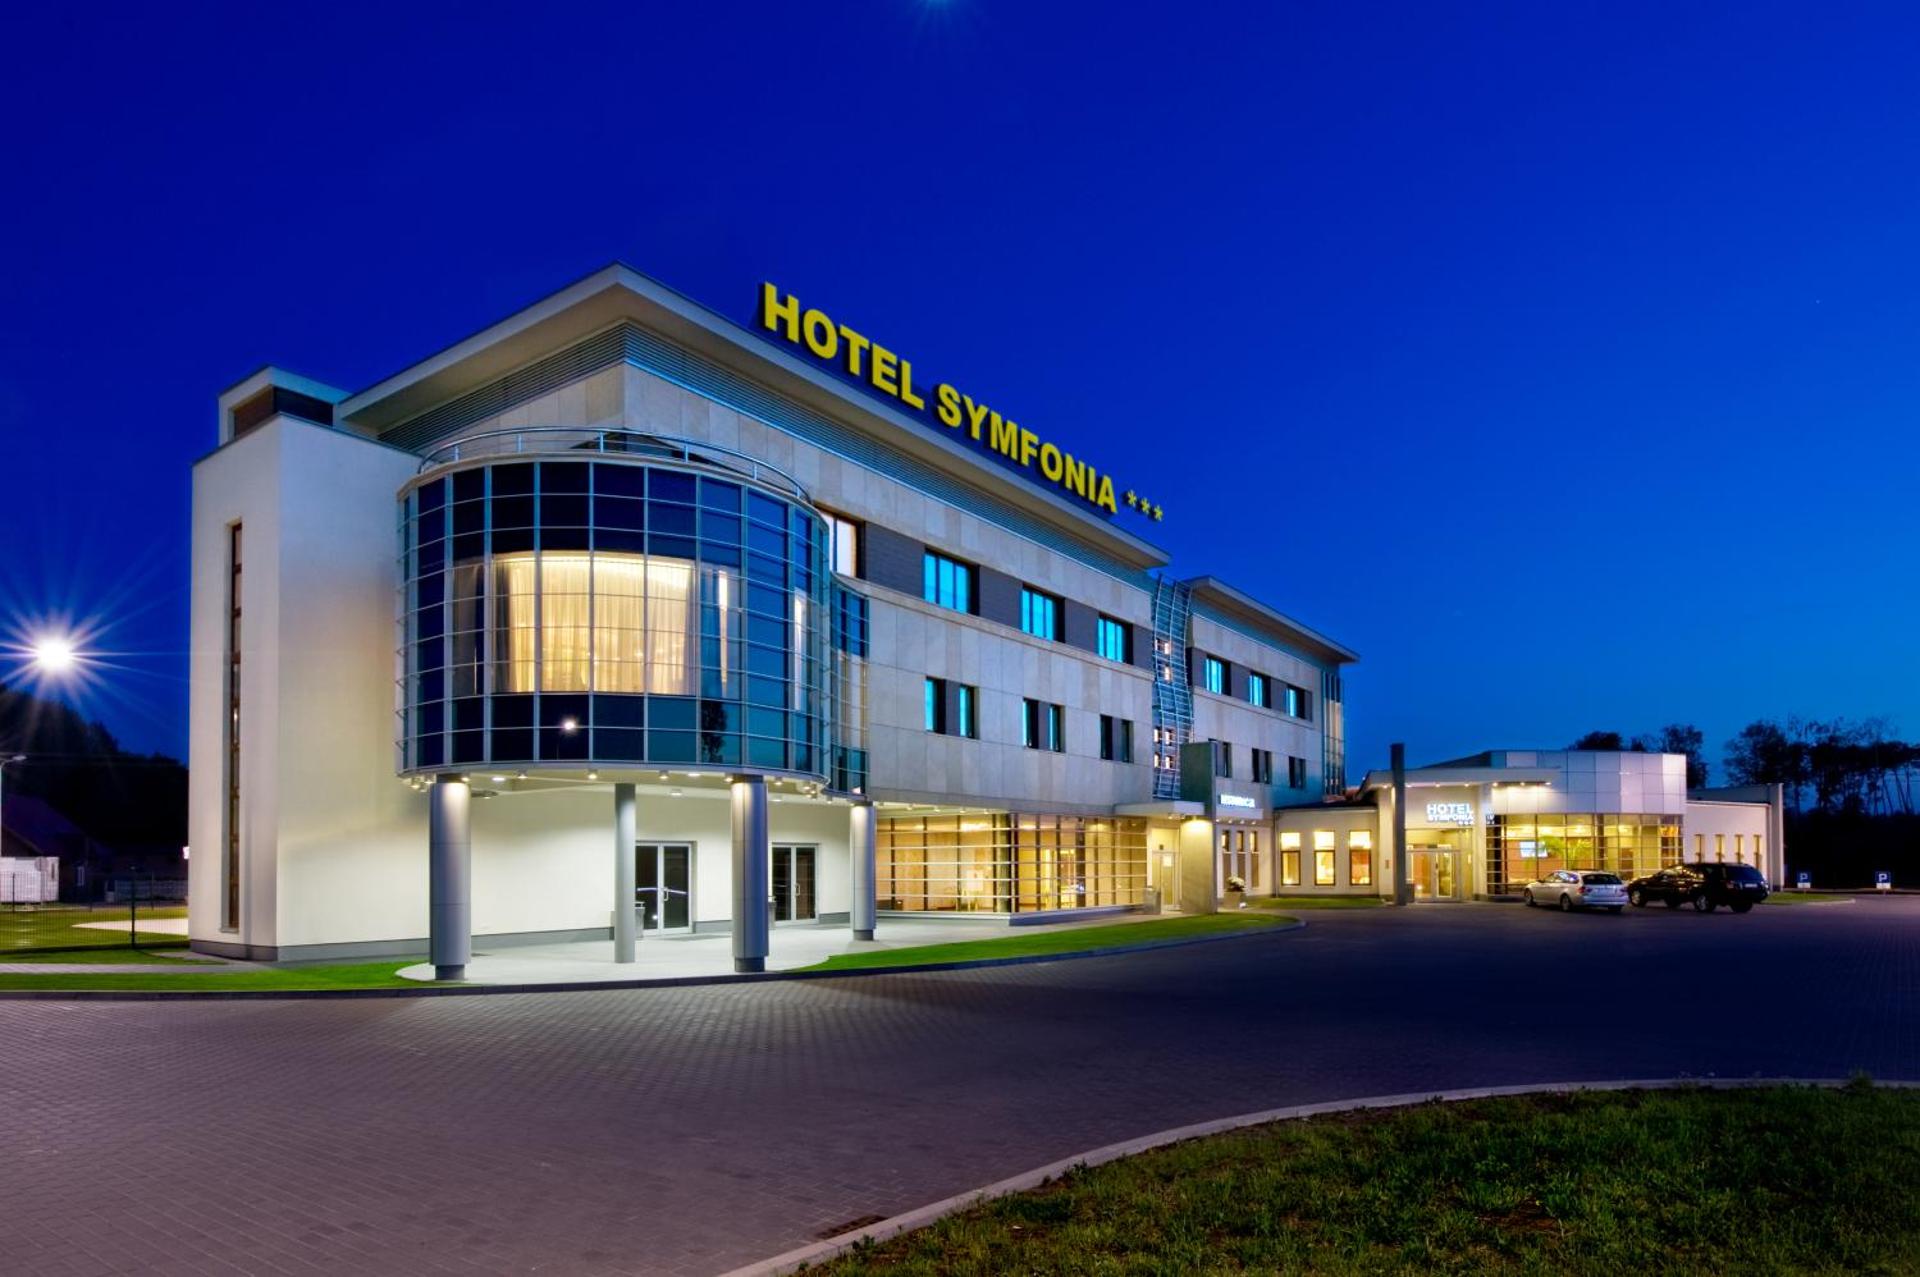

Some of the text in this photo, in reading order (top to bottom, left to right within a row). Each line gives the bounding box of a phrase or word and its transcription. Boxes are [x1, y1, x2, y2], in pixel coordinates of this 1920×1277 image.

[763, 281, 1117, 513] HOTEL SYMFONIA
[1426, 803, 1473, 814] HOTEL
[1800, 872, 1808, 883] P
[1878, 873, 1887, 882] P
